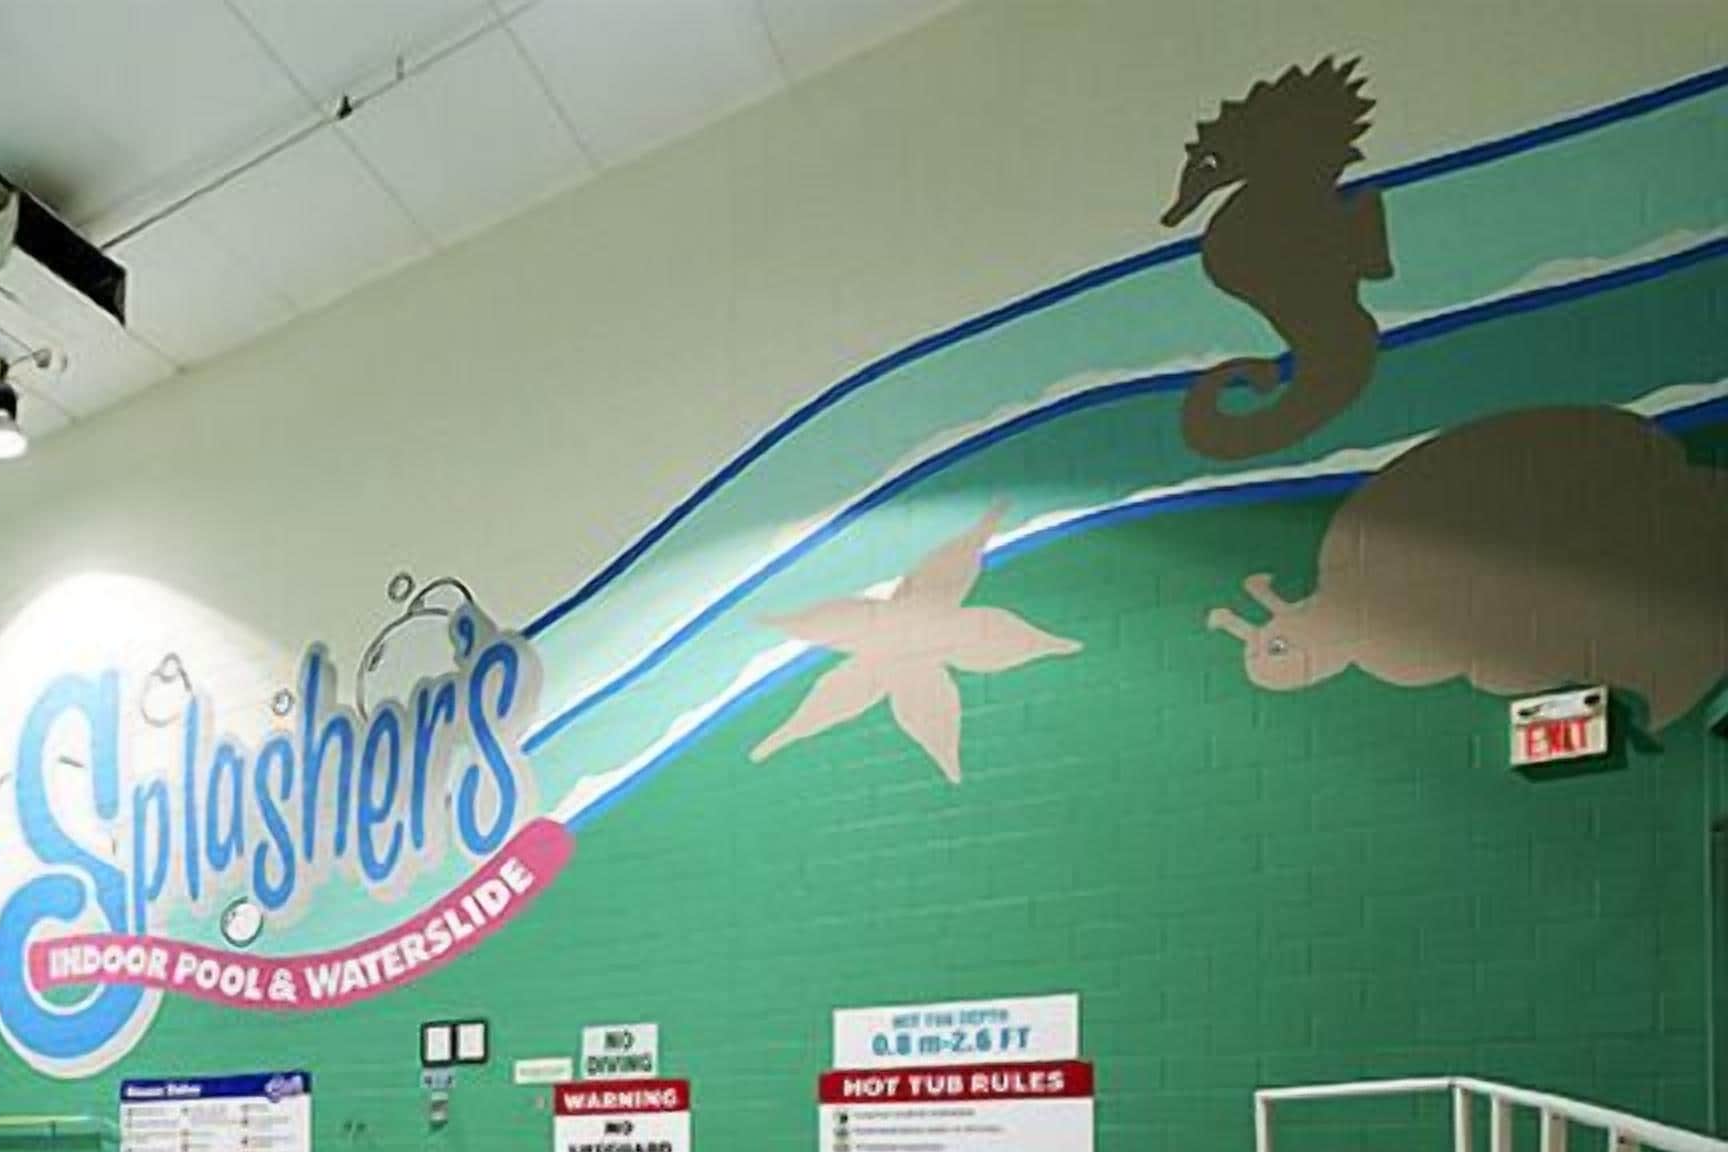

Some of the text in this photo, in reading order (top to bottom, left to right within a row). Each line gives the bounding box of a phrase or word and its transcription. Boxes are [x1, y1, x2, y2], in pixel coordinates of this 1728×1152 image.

[1526, 717, 1588, 760] EXIT
[48, 857, 535, 1003] INDOOR POOL & WATERSLIDE
[604, 1029, 635, 1051] NO
[587, 1053, 652, 1075] DIVING
[843, 1070, 1066, 1098] HOT TUB RULES
[563, 1088, 678, 1111] WARNING
[604, 1120, 634, 1136] NO
